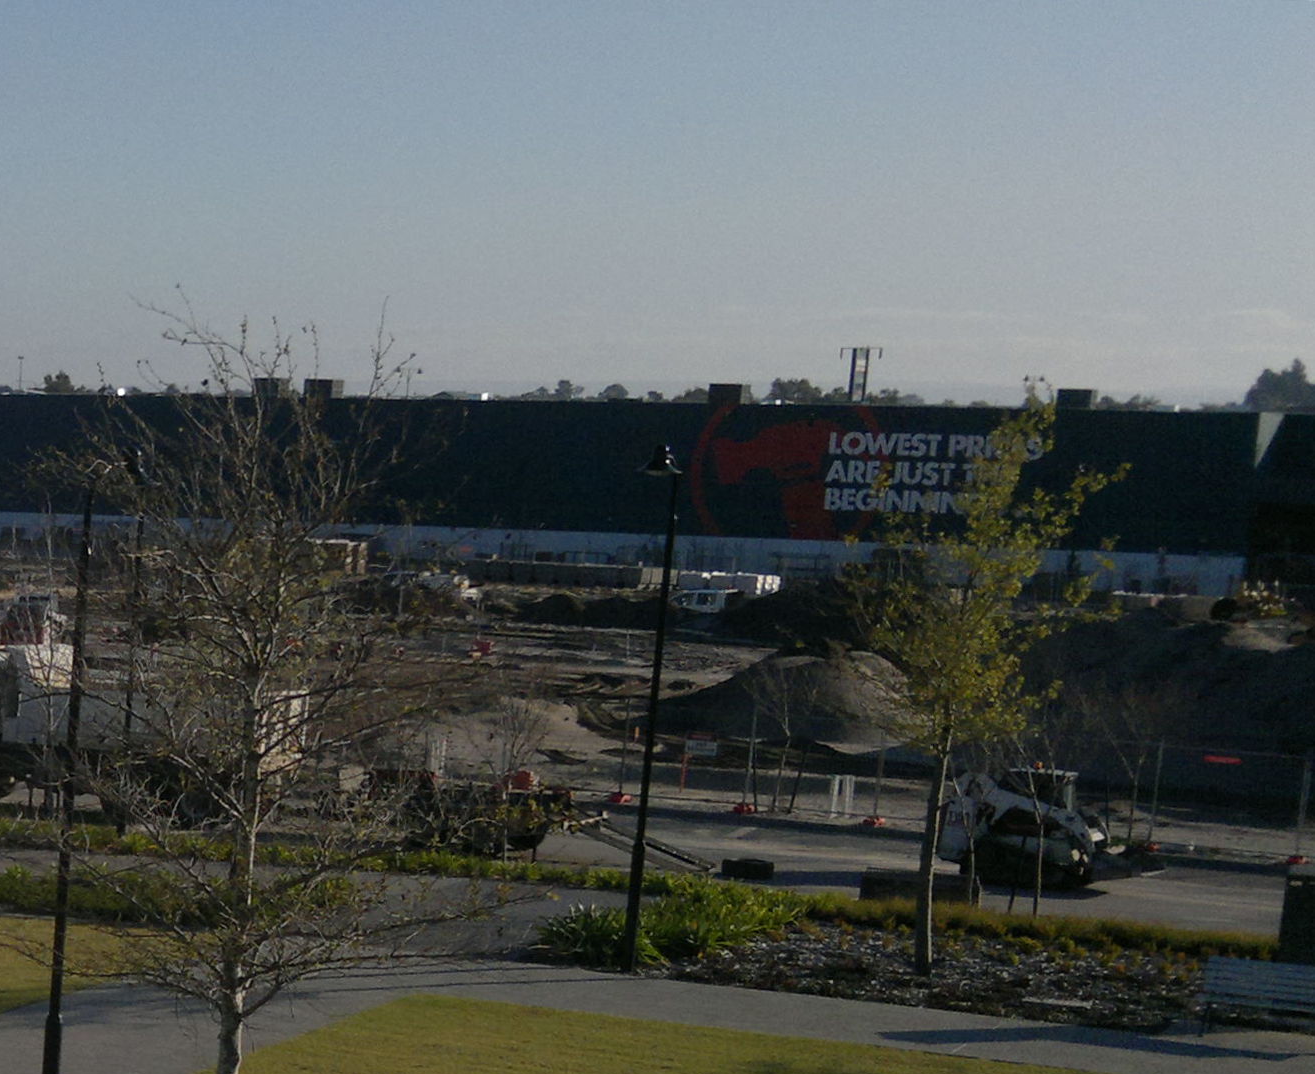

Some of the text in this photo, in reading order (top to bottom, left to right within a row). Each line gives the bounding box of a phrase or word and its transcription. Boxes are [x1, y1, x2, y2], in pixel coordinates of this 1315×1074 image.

[828, 431, 942, 458] LOWEST
[825, 459, 881, 485] ARE
[892, 461, 957, 487] JUST
[824, 487, 981, 515] BEGINNIN
